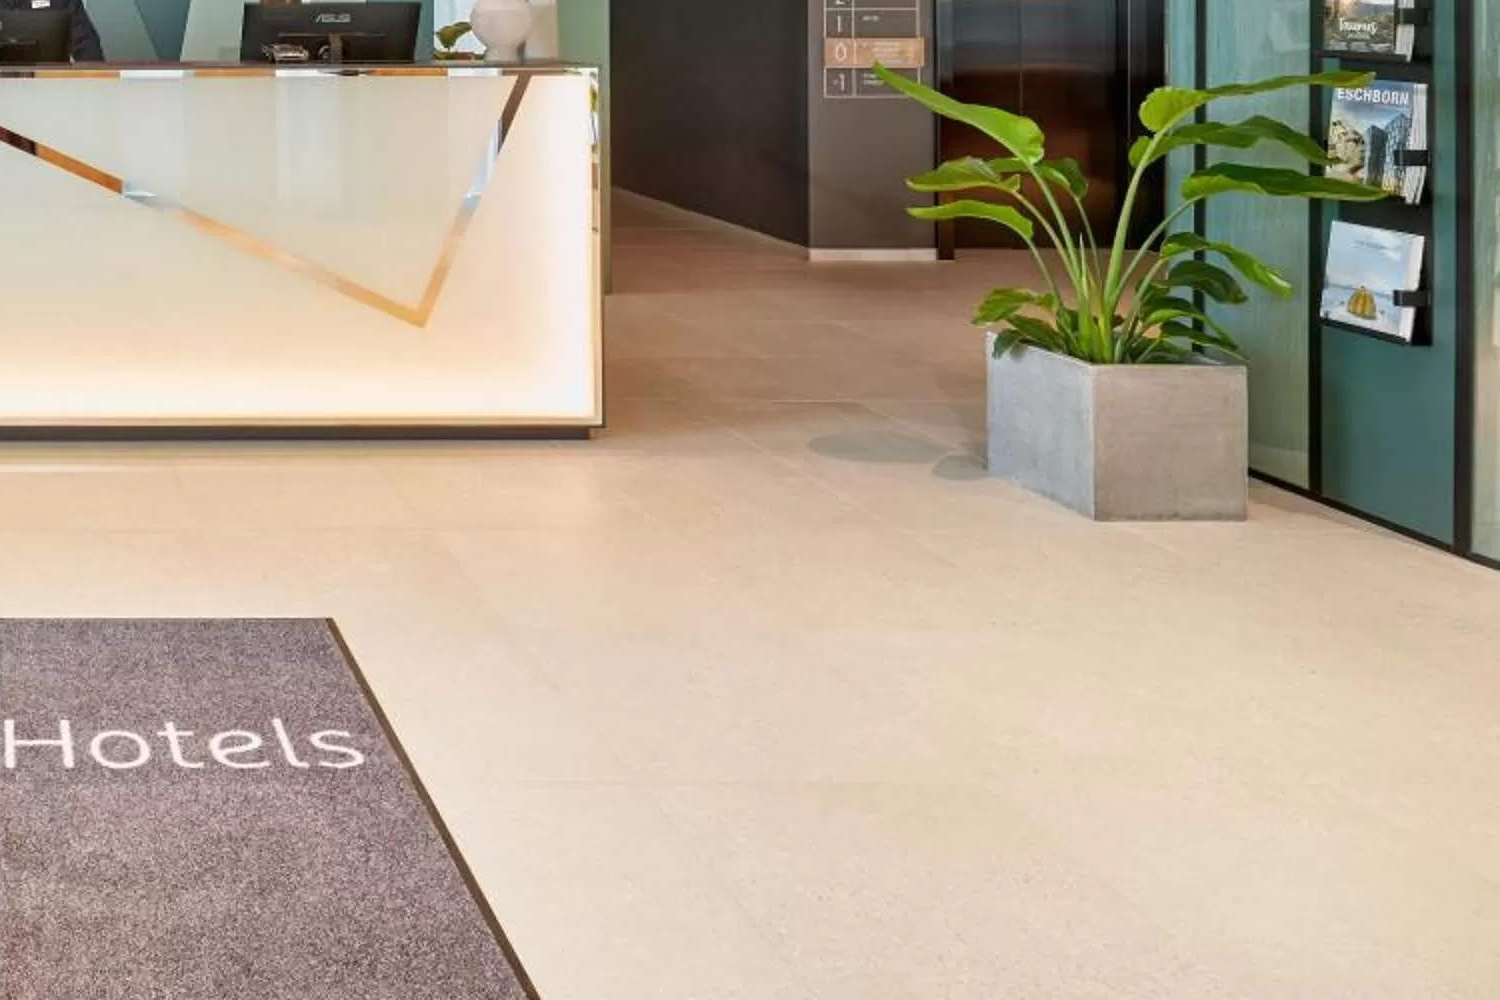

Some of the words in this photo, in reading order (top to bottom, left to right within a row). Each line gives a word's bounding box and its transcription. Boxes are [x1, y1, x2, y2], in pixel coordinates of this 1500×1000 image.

[836, 14, 842, 33] 1
[835, 41, 847, 61] 0
[1337, 87, 1410, 105] ESCHBORN
